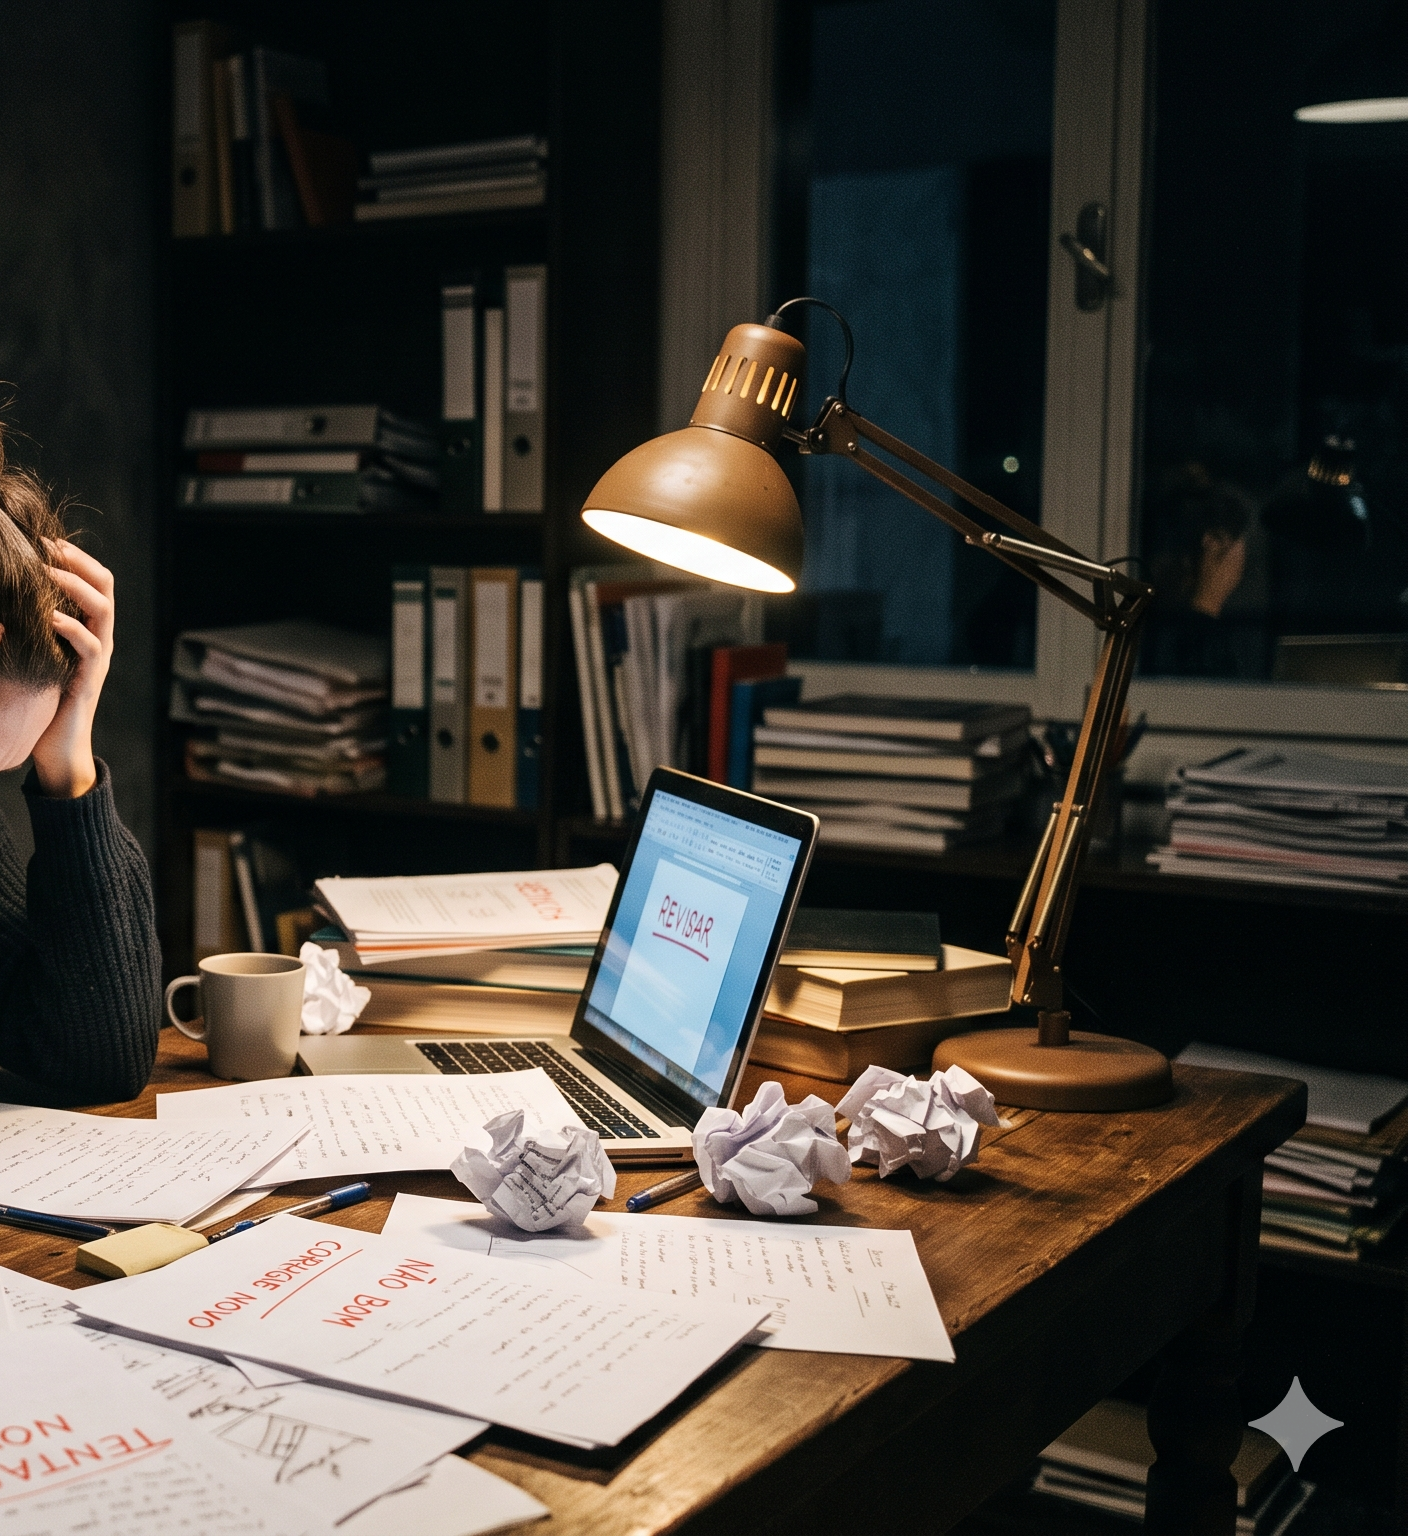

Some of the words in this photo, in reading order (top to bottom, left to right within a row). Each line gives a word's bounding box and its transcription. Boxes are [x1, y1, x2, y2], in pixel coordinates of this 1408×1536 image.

[657, 894, 714, 949] REVISAR
[187, 1291, 257, 1329] NOVO
[322, 1293, 391, 1329] BOM
